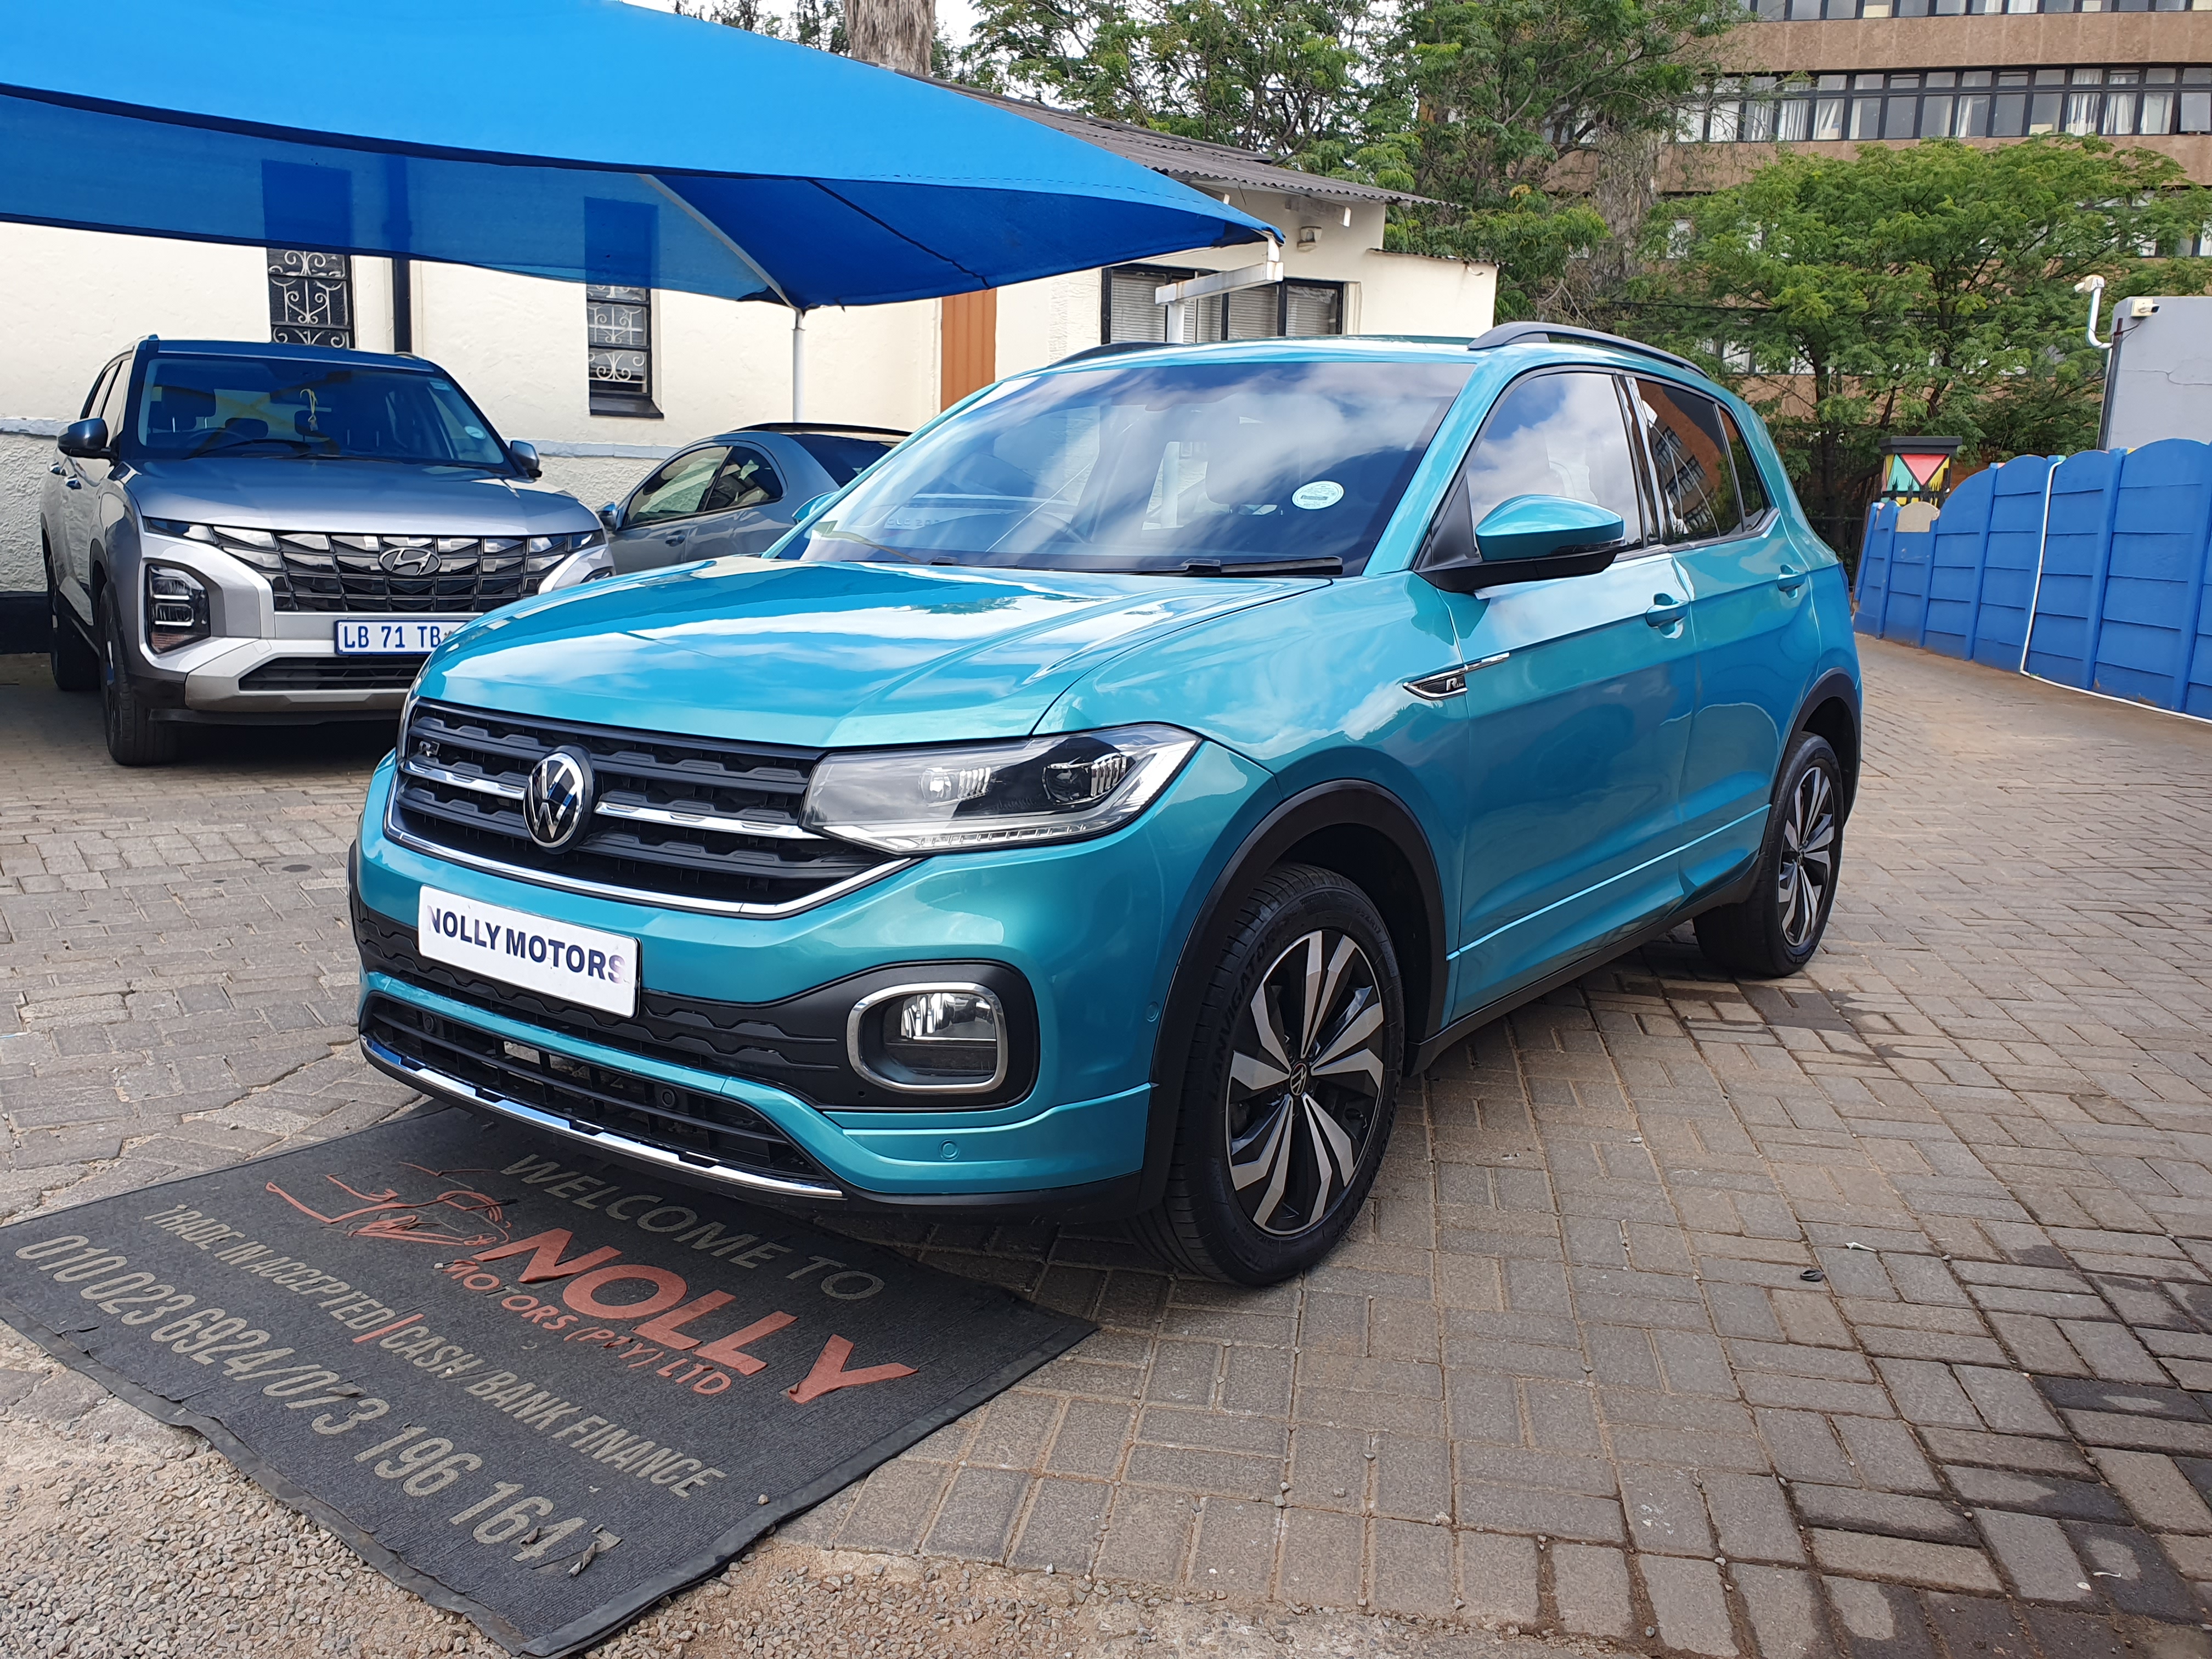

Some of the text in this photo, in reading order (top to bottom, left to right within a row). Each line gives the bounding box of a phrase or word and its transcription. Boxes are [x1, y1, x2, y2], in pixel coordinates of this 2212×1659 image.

[344, 626, 441, 648] LB 71 TB
[1446, 678, 1457, 691] R
[427, 905, 627, 984] NOLLY MOTORS
[500, 1154, 885, 1300] WELCOME TO
[15, 1235, 128, 1283] 010
[80, 1271, 196, 1325] 023
[354, 1422, 483, 1497] 196
[144, 1205, 246, 1250] TRADE
[214, 1240, 274, 1265] IN
[550, 1414, 727, 1498] FINANCE
[441, 1259, 579, 1330] MOTORS
[656, 1358, 732, 1394] LTD
[471, 1228, 919, 1403] NOLLY
